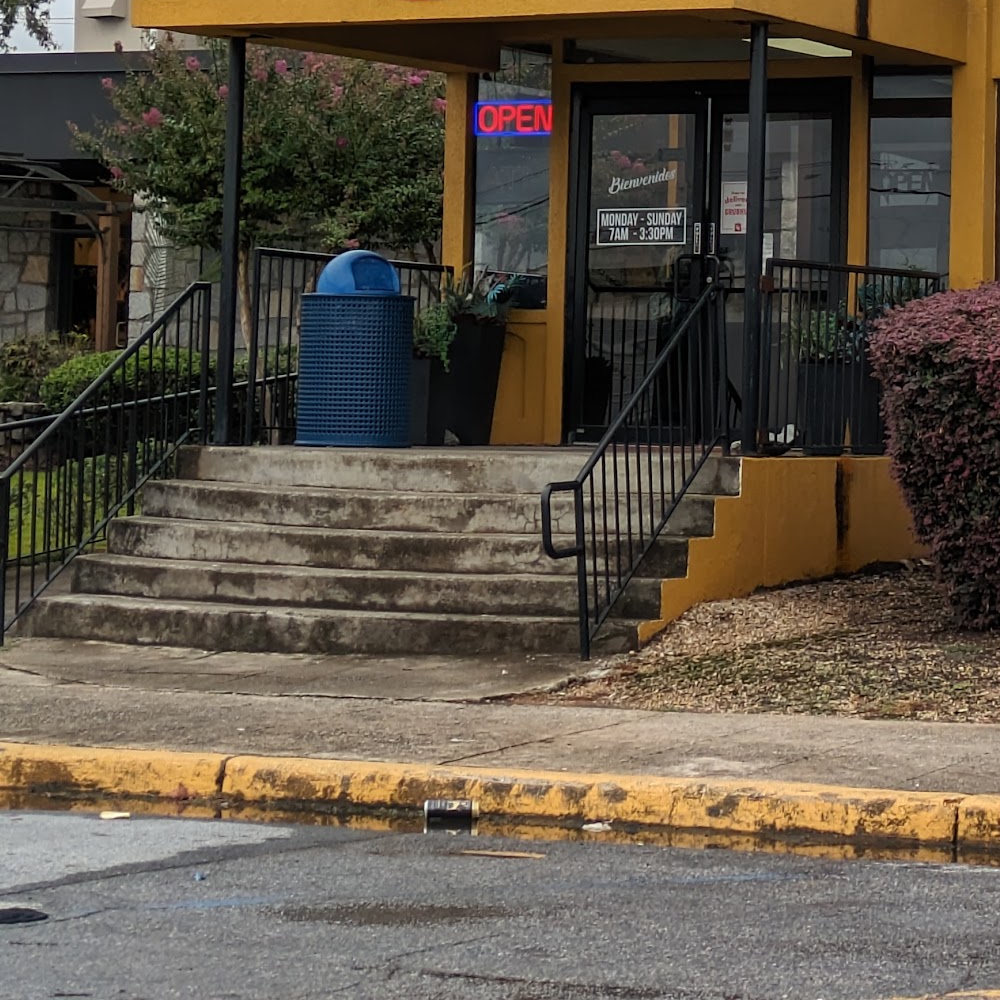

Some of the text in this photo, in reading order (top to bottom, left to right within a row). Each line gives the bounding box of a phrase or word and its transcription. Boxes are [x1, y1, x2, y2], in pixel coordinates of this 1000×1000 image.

[478, 103, 554, 133] OPEN
[608, 168, 677, 194] Bienvenidos
[600, 212, 639, 227] MONDAY
[646, 211, 683, 226] SUNDAY
[608, 227, 629, 241] 7AM
[639, 226, 674, 241] 3:30PM
